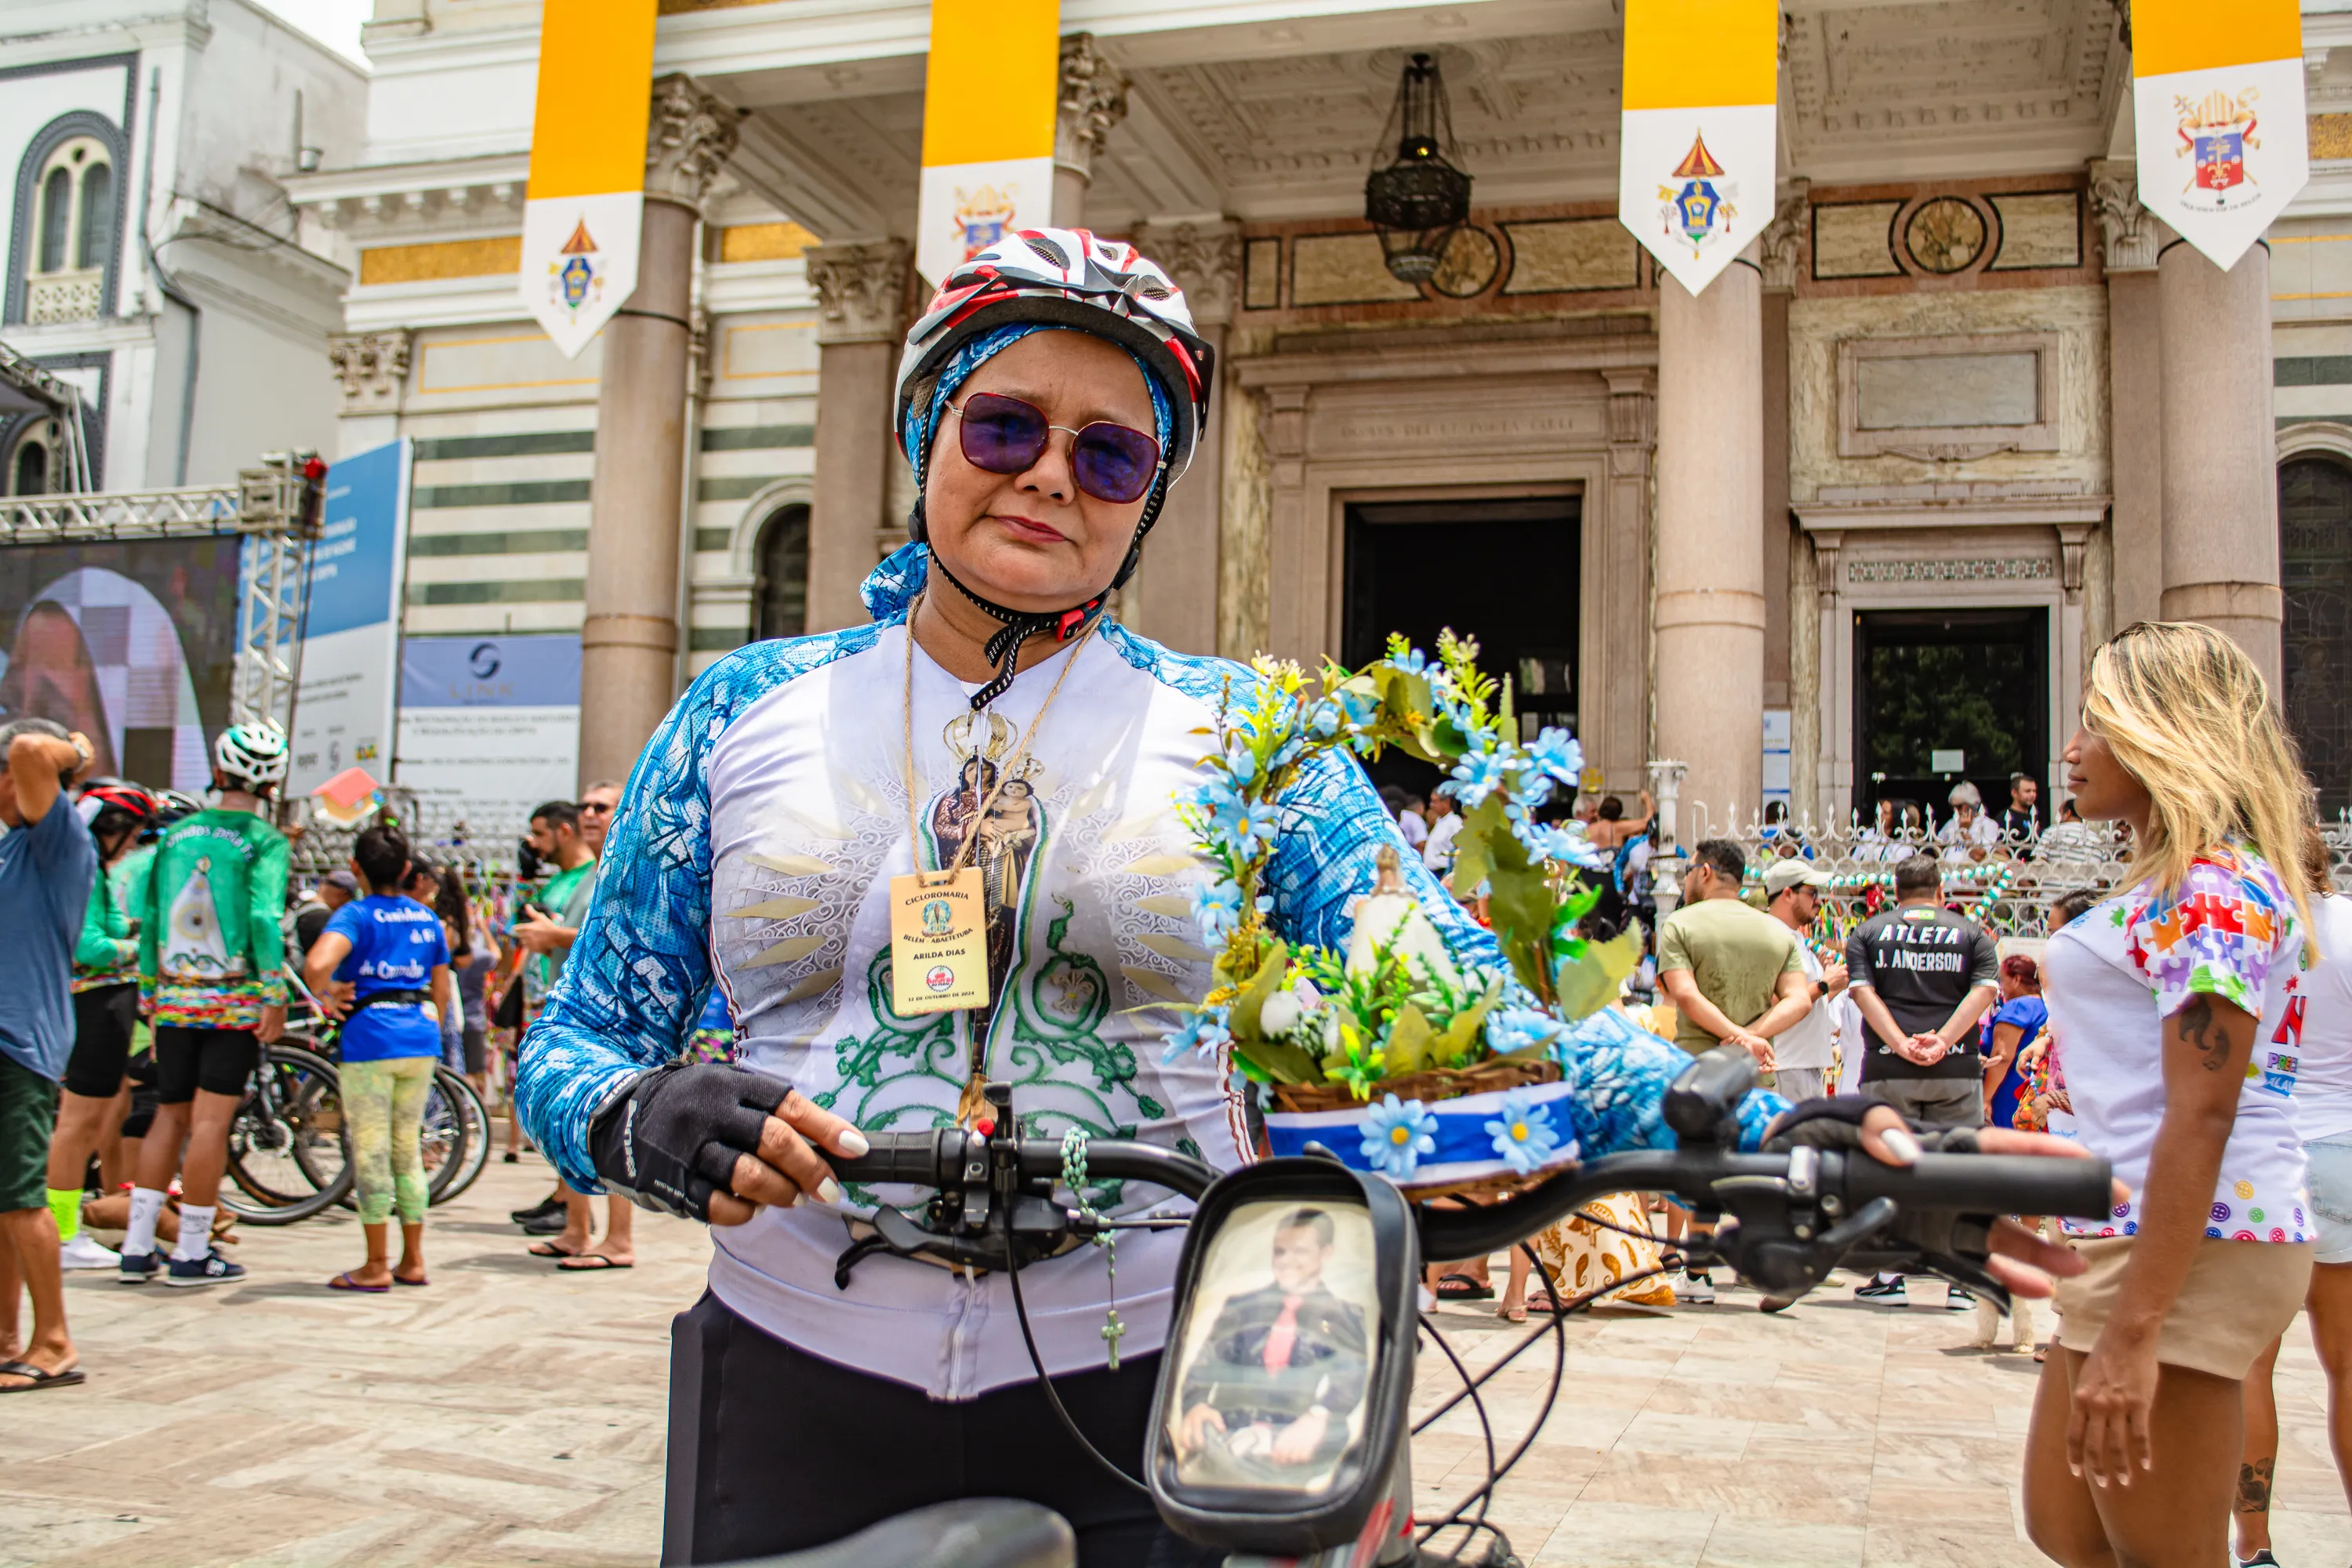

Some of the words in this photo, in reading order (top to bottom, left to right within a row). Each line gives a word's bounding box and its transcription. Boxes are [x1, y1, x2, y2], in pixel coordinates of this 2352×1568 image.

[449, 681, 514, 699] LINK
[905, 891, 969, 906] CICLOROMARIA
[903, 934, 924, 943] BELÉM
[931, 927, 973, 943] ABAETETUBA
[1878, 924, 1961, 945] ATLETA
[913, 951, 943, 960] ARILDA
[946, 948, 966, 956] DIAS
[1875, 949, 1888, 969] J.
[1891, 949, 1962, 973] ANDERSON
